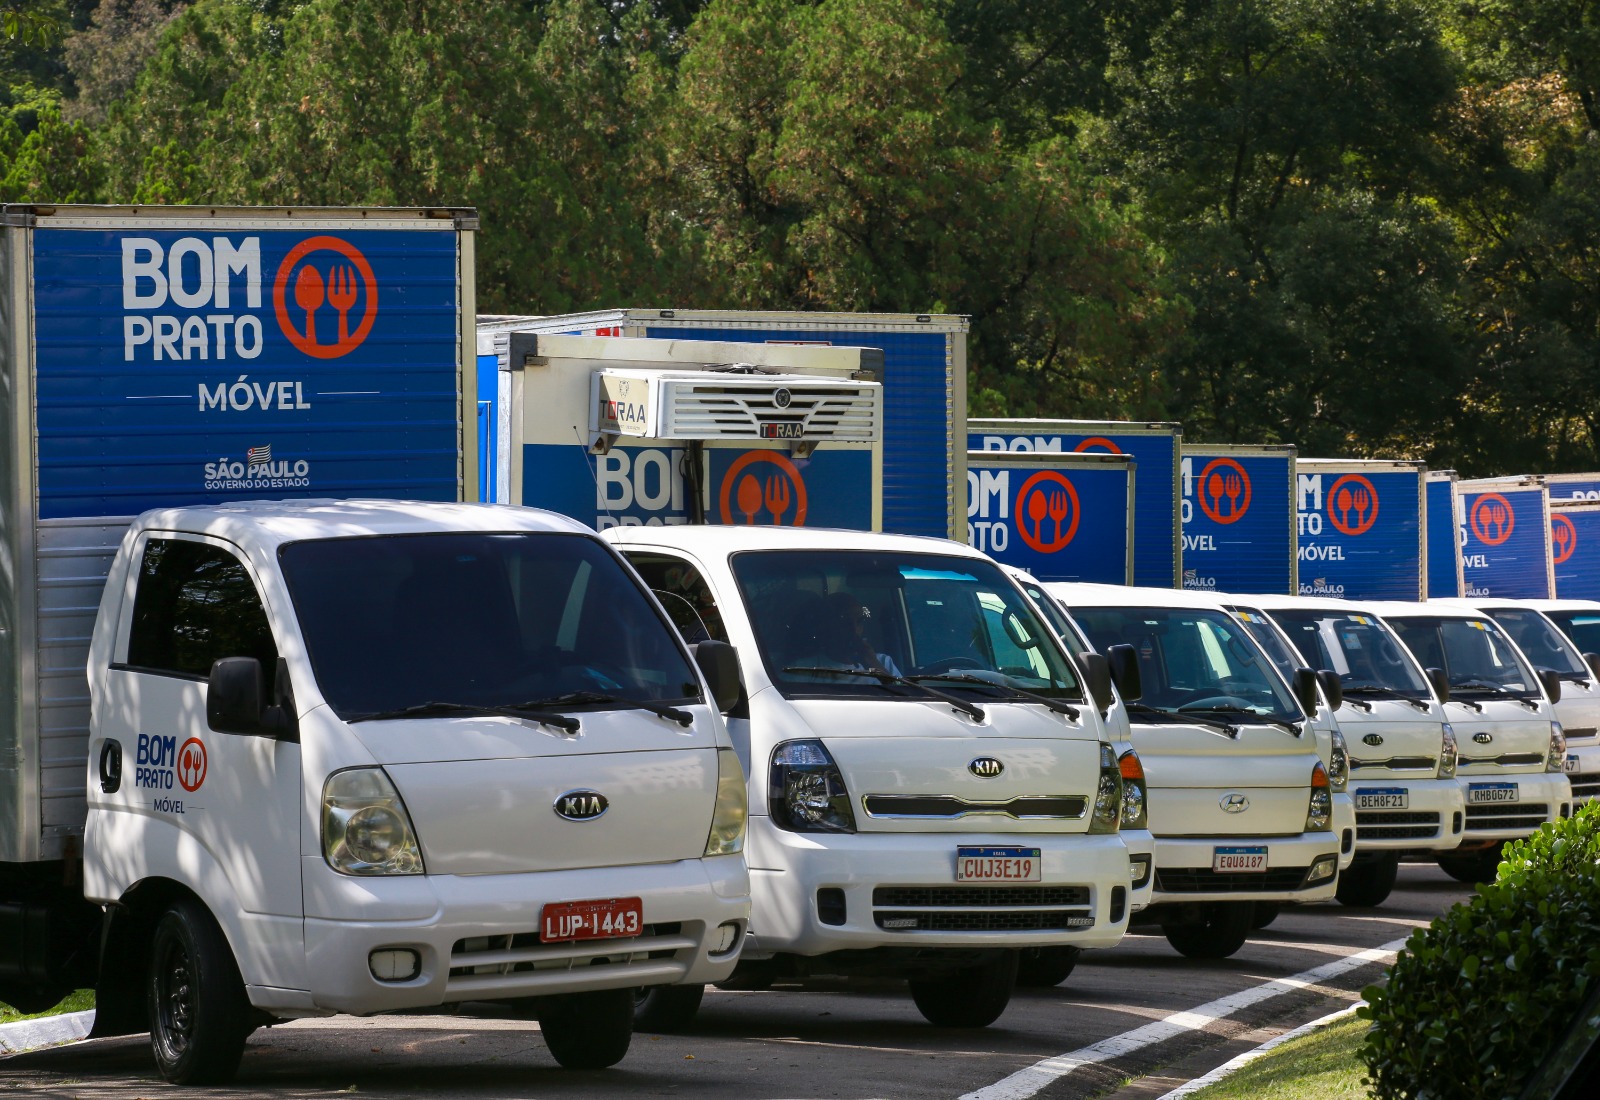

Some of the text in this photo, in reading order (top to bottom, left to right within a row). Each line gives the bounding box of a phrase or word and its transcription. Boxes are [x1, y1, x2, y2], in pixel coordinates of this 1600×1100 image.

[121, 236, 262, 310] BOM
[123, 314, 263, 361] PRATO
[198, 374, 311, 412] MÓVEL
[600, 400, 646, 424] TORAA
[761, 423, 802, 438] TORAA
[204, 457, 309, 480] SÃO PAULO
[204, 477, 310, 489] GOVERNO DO ESTADO
[1463, 554, 1489, 568] VEL
[1299, 583, 1313, 594] ÃO
[136, 733, 177, 767] BOM
[974, 760, 1000, 774] KIA
[135, 767, 174, 789] PRATO
[153, 796, 185, 814] MÓVEL
[564, 796, 601, 815] KIA
[1361, 795, 1404, 808] BEH8F21
[964, 859, 1032, 879] CUJ3E19
[546, 910, 638, 938] LUP-1443
